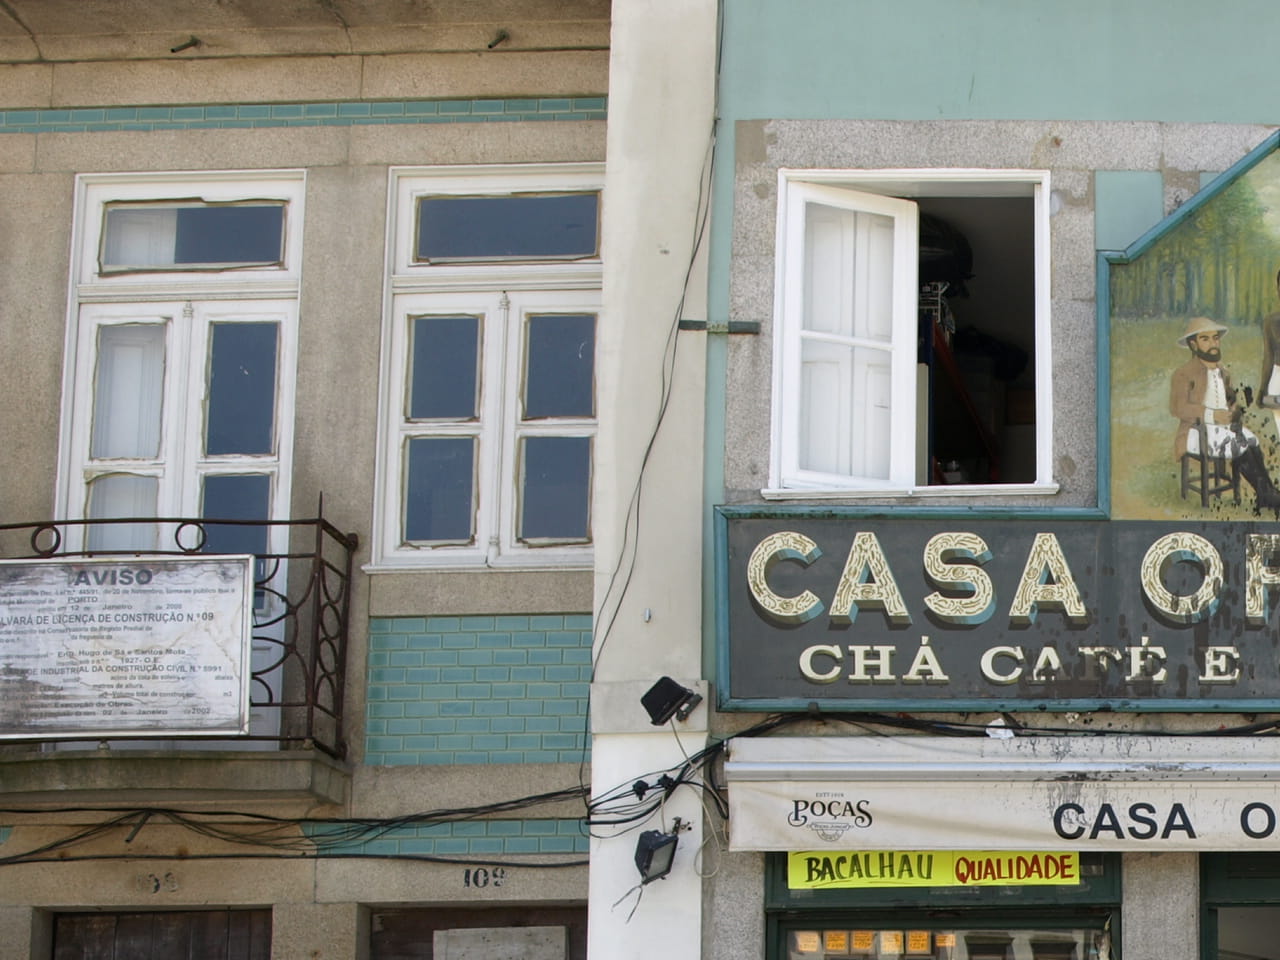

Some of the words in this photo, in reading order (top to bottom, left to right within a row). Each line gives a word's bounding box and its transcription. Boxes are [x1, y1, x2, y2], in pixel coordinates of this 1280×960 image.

[74, 568, 152, 586] AVISO
[746, 530, 1090, 626] CASA
[0, 613, 33, 626] LVARÁ
[36, 615, 50, 625] DE
[52, 613, 96, 626] LICENÇA
[98, 613, 112, 623] DE
[114, 611, 184, 624] CONSTRUÇÃO
[201, 611, 214, 622] 09
[91, 664, 104, 673] DA
[105, 663, 164, 674] CONSTRUÇÃO
[798, 636, 949, 685] CHÁ
[980, 636, 1168, 685] CAFÉ
[1198, 645, 1241, 685] E
[787, 799, 873, 828] POÇAS
[1053, 801, 1198, 840] CASA
[804, 852, 934, 883] BACALHAU
[954, 853, 1075, 884] QUALIDADE
